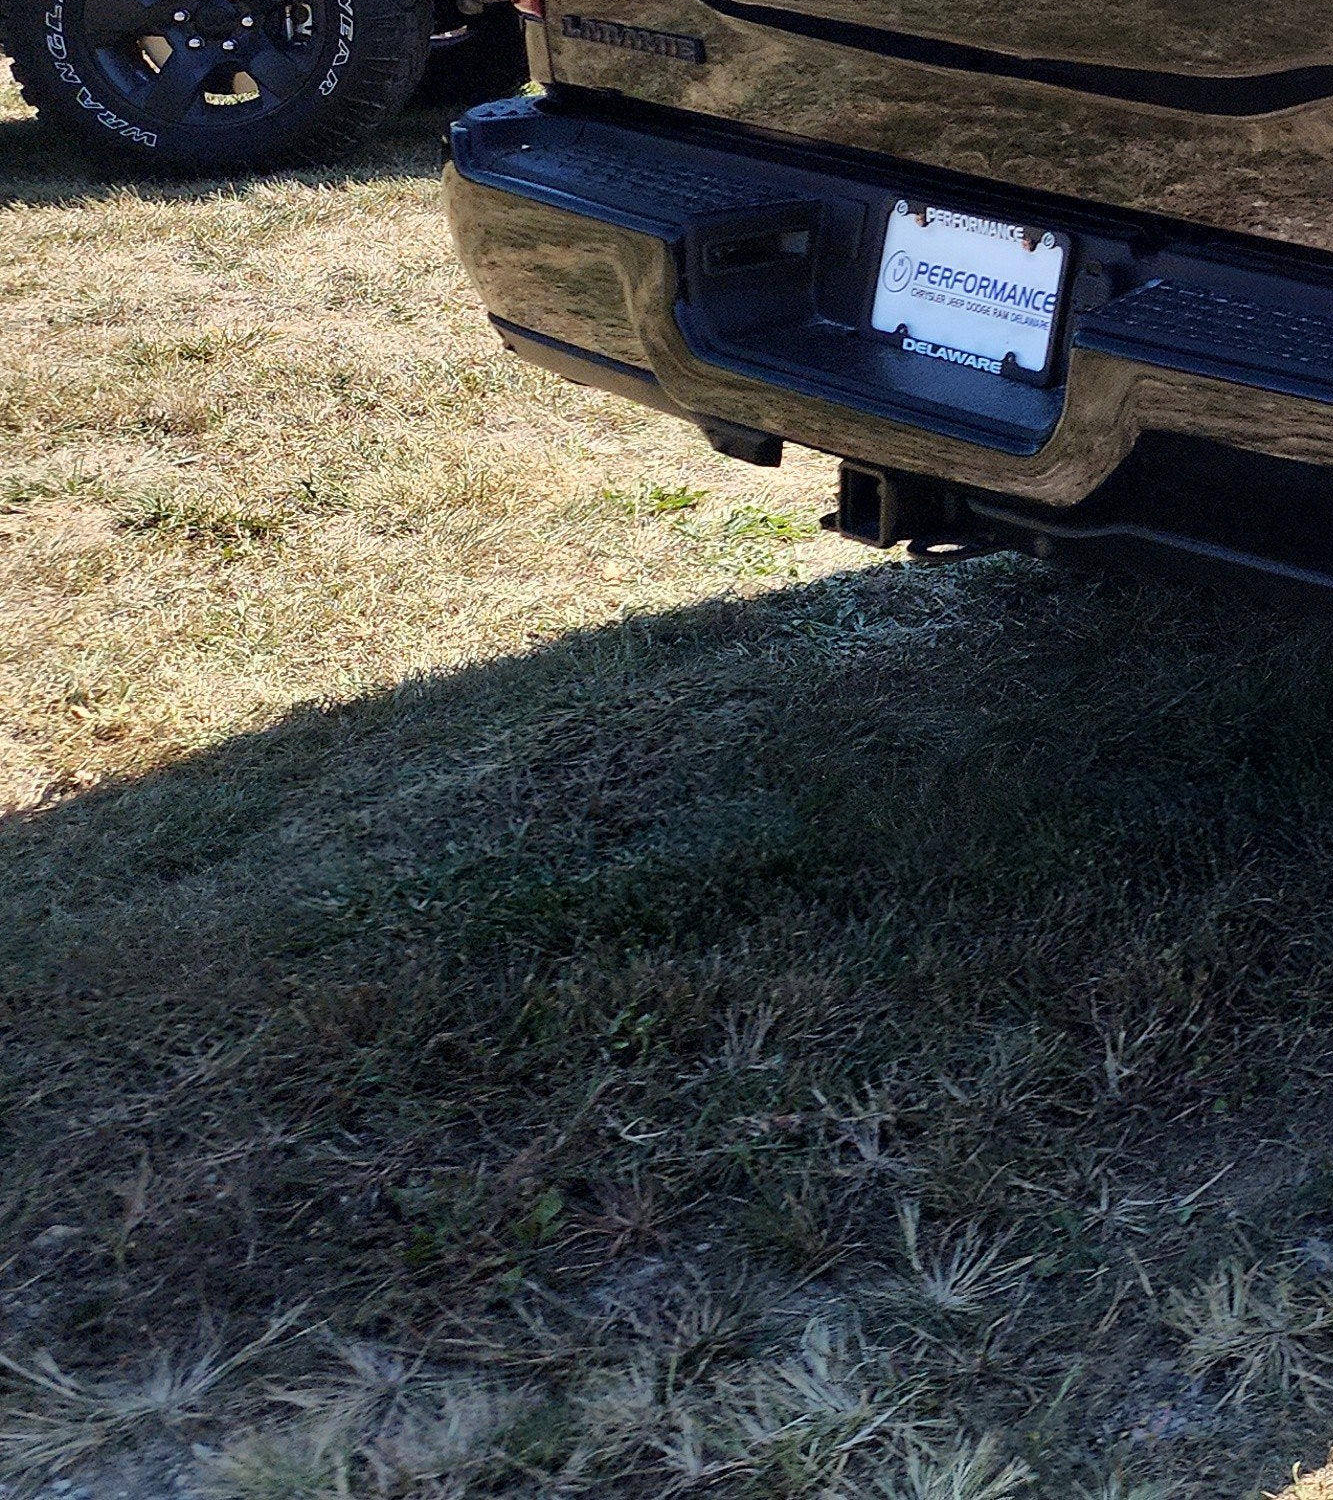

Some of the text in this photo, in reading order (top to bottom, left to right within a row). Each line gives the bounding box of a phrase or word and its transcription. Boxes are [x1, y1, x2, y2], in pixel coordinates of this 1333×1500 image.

[925, 207, 1025, 242] PERFORMANCE
[910, 287, 946, 304] CHRYSLER
[947, 297, 965, 309] JEEP
[966, 301, 991, 316] DODGE
[993, 307, 1010, 320] RAM
[914, 261, 1057, 314] PERFORMANCE
[902, 337, 1003, 376] DELAWARE
